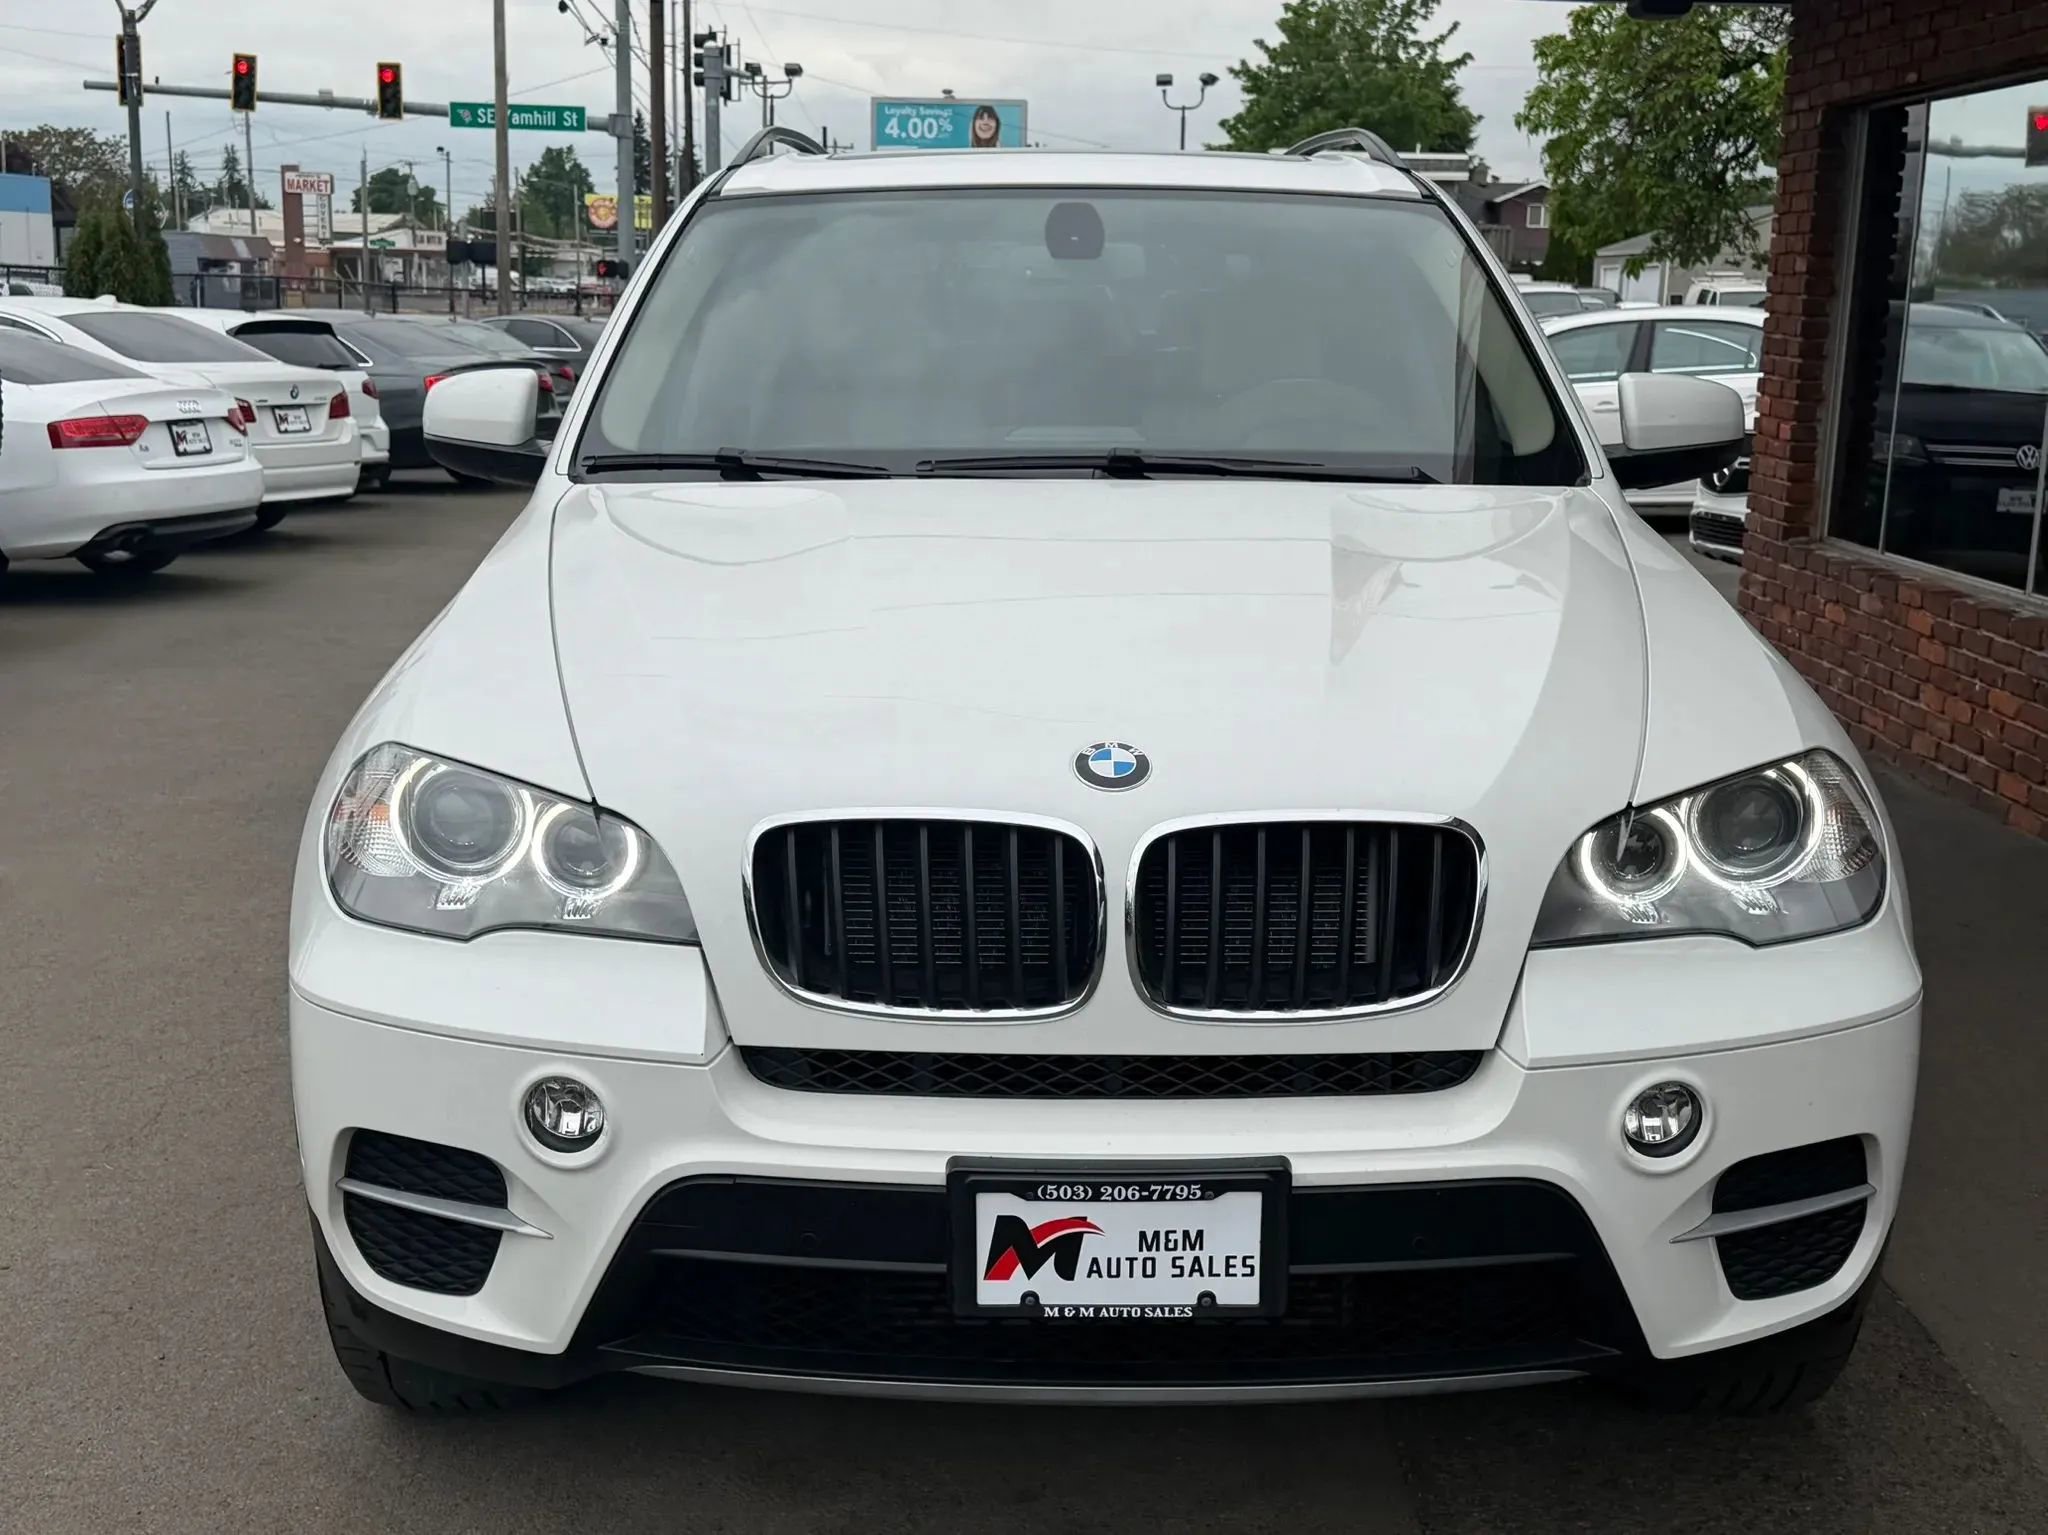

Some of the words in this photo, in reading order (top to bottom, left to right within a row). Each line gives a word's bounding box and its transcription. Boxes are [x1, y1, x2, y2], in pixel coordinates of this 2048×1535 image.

[477, 108, 495, 124] SE
[563, 111, 578, 127] St
[885, 117, 953, 139] 4.00%
[287, 178, 330, 193] MARKET
[1079, 741, 1146, 756] BMW
[1037, 1184, 1093, 1200] (503)
[1100, 1184, 1202, 1201] 206-7795
[1086, 1256, 1157, 1279] AUTO
[1171, 1255, 1255, 1278] SALES
[1044, 1307, 1060, 1317] M
[1064, 1307, 1076, 1317] &
[1079, 1307, 1095, 1317] M
[1100, 1307, 1141, 1317] AUTO
[1144, 1307, 1193, 1318] SALES
